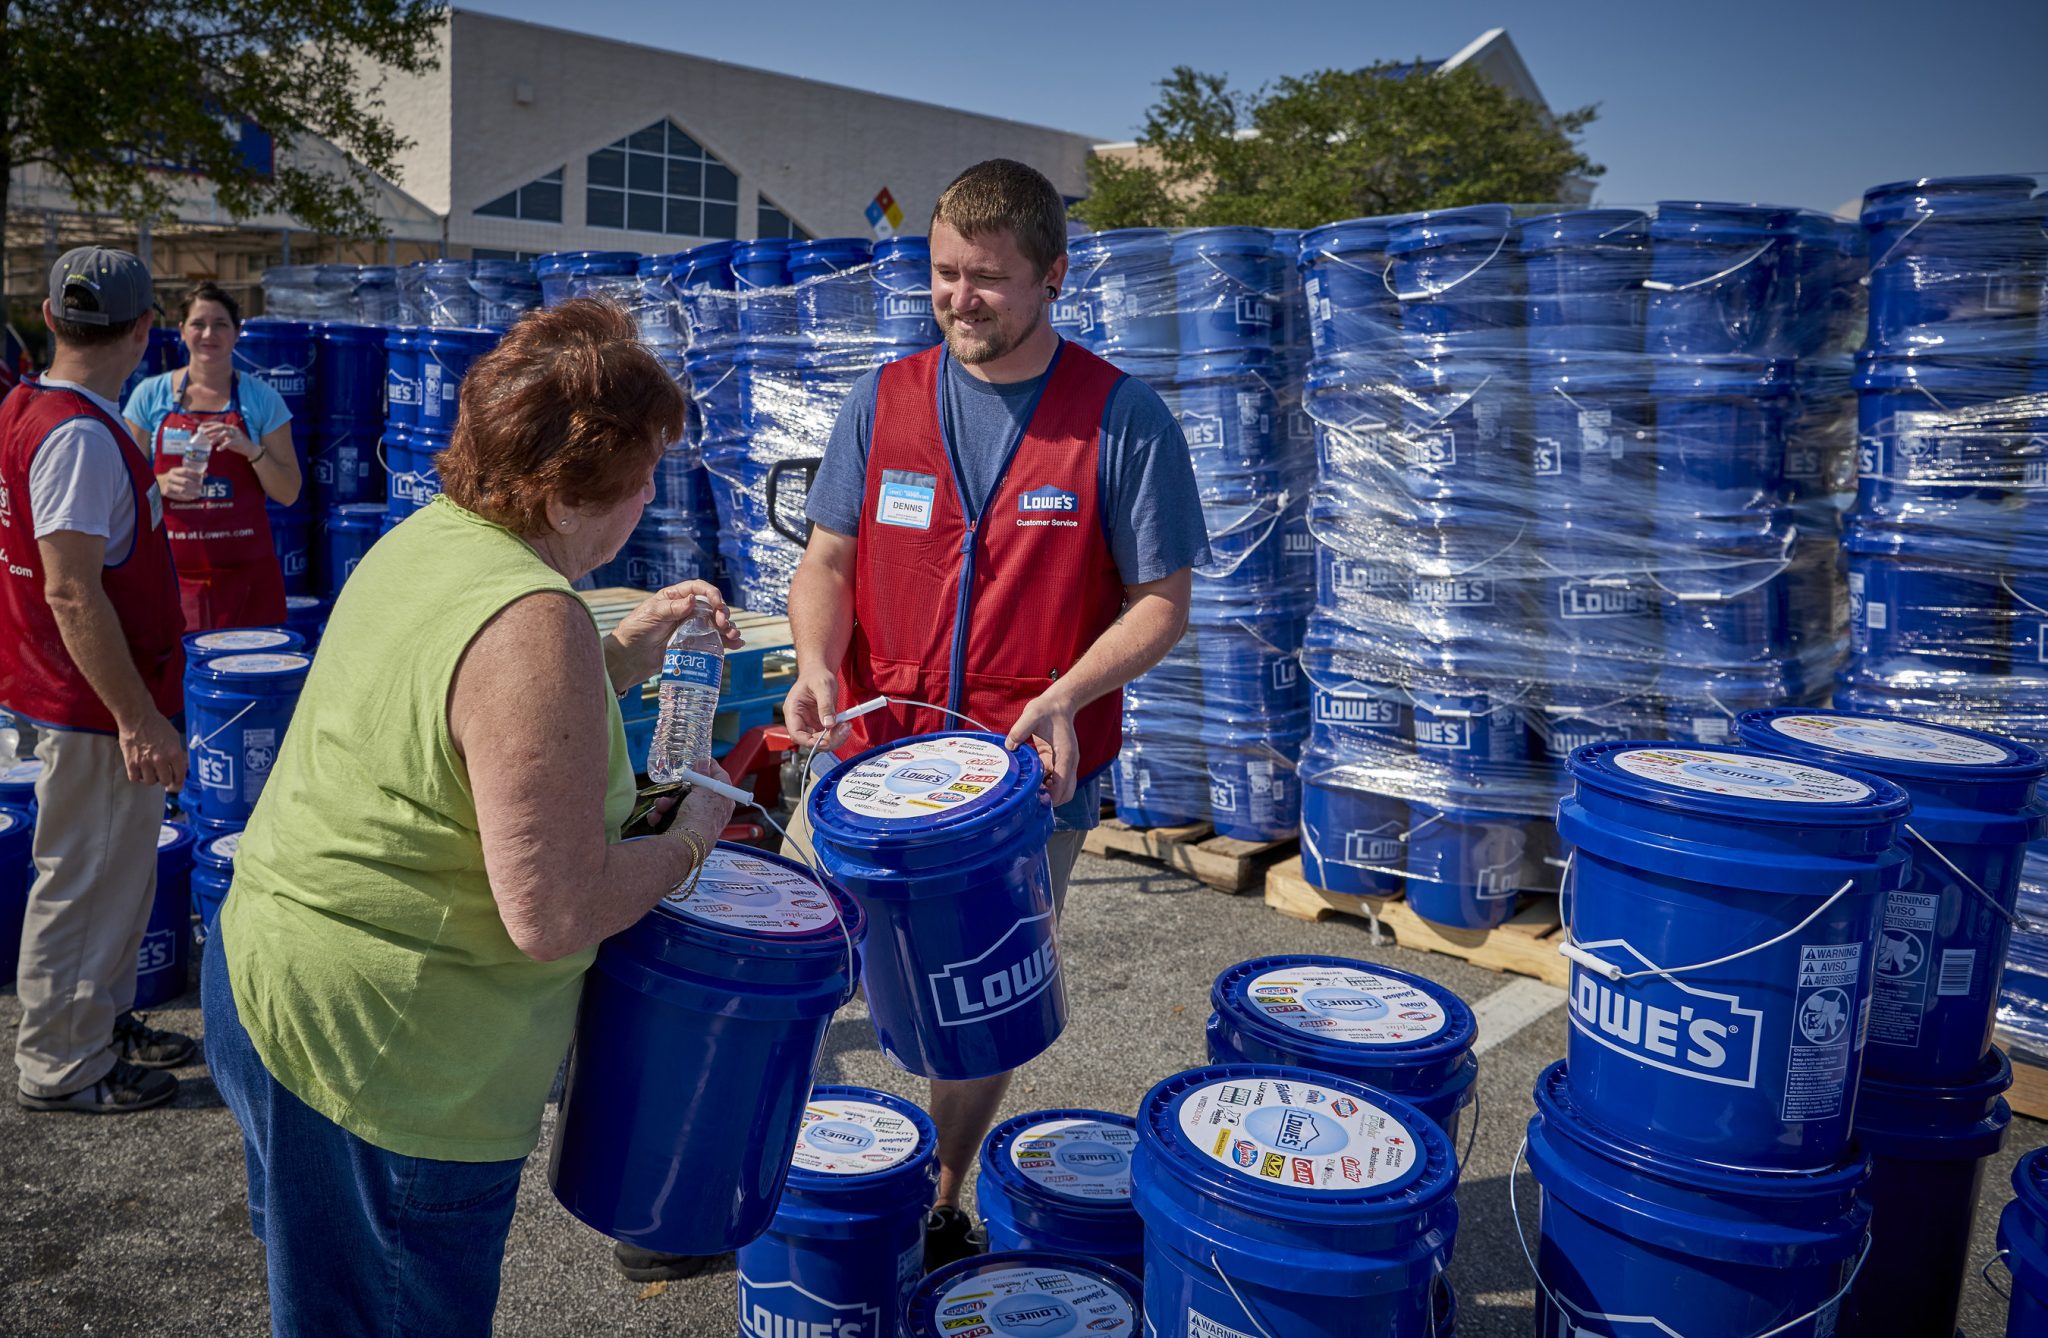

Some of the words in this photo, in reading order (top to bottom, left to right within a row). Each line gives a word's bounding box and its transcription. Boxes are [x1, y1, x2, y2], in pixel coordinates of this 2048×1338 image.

[889, 299, 932, 315] LOWE
[389, 384, 412, 401] E'S
[1187, 423, 1214, 443] E'S
[169, 502, 205, 510] Customer
[893, 502, 923, 513] DENNIS
[1023, 494, 1074, 510] LOWE'S
[1016, 519, 1050, 527] Customer
[1051, 518, 1078, 527] Service
[199, 529, 255, 540] Lowes.com
[1320, 699, 1394, 721] LOWE'S
[1416, 719, 1460, 744] WE'S
[200, 756, 224, 783] E'S
[900, 769, 945, 784] LOWE'S
[1706, 766, 1778, 786] LOWE'S
[965, 774, 996, 783] GLAD
[1889, 893, 1931, 906] ARNING
[1884, 917, 1932, 930] ERTISSEMENT
[138, 941, 167, 969] E'S
[1816, 946, 1858, 959] WARNING
[1820, 961, 1848, 972] AVISO
[953, 936, 1056, 1014] LOWE
[1813, 973, 1857, 985] AVERTISSEMENT
[1268, 1005, 1303, 1013] GLAD
[1314, 998, 1374, 1008] LOWE'S
[1256, 1081, 1268, 1094] LUX
[1273, 1082, 1294, 1104] Fabuloso
[1253, 1093, 1264, 1105] PRO
[1305, 1090, 1320, 1104] DAWN
[818, 1129, 863, 1144] LOWE'S
[1281, 1113, 1308, 1147] LOWE'S
[1023, 1160, 1053, 1168] GLAD
[1067, 1153, 1116, 1162] LOWE'S
[1393, 1148, 1403, 1168] American
[1294, 1159, 1312, 1183] GLAD
[1340, 1156, 1361, 1183] Cutter
[1072, 1288, 1109, 1306] Fabuloso
[1004, 1306, 1062, 1323] LOWE'S
[1201, 1318, 1243, 1338] WARNIN
